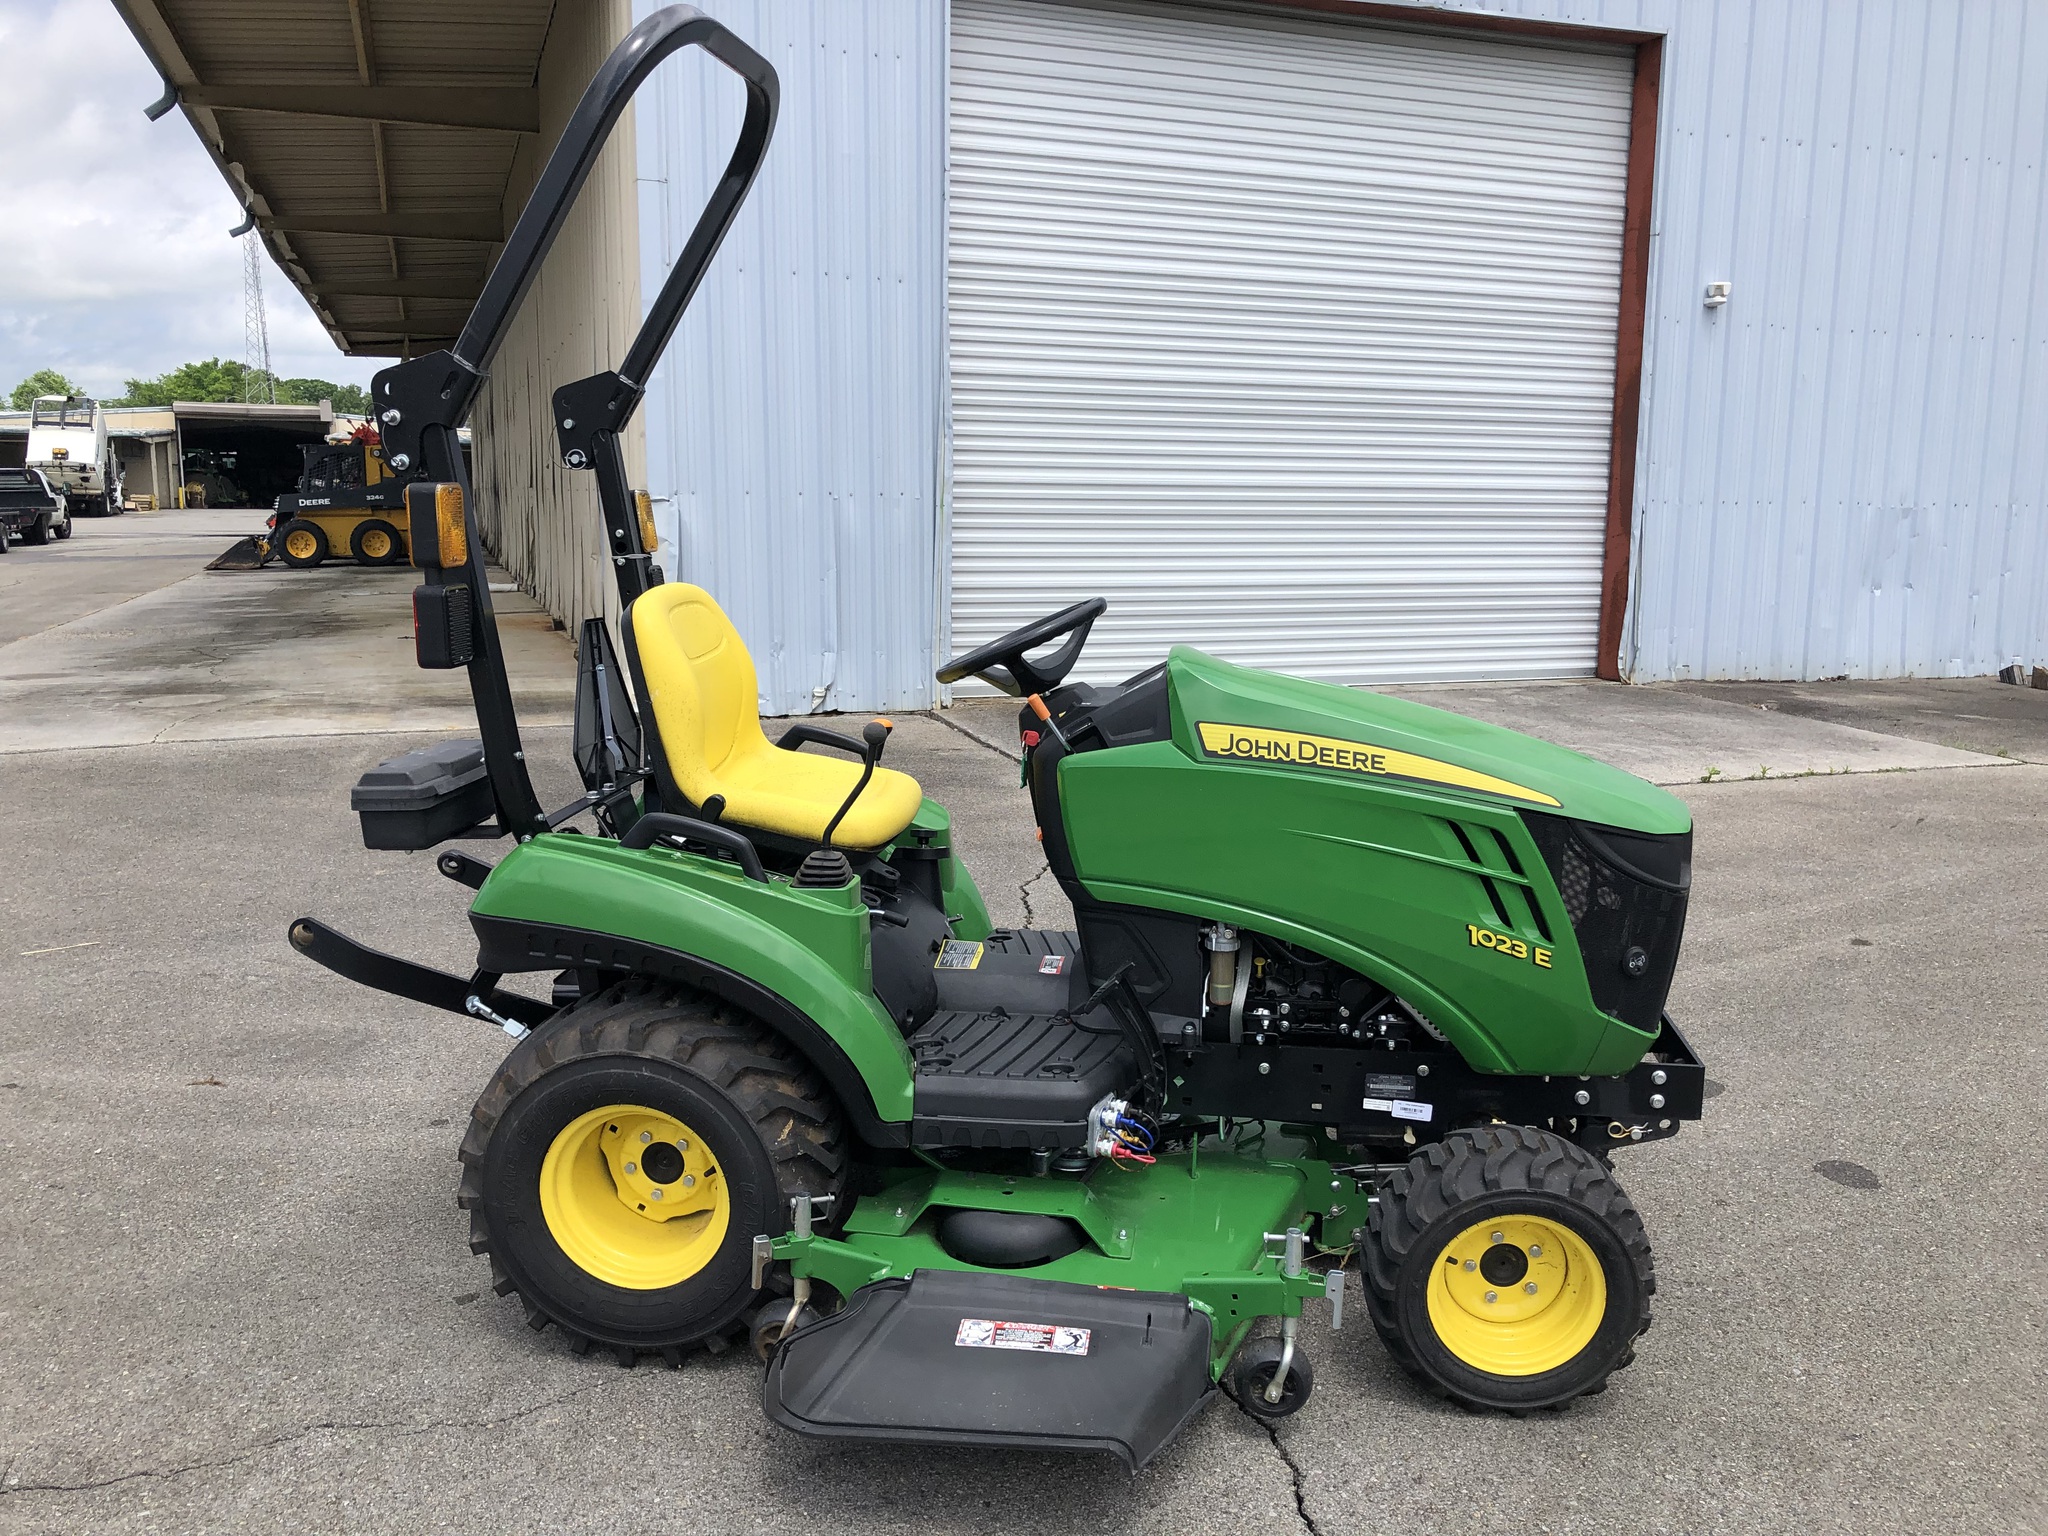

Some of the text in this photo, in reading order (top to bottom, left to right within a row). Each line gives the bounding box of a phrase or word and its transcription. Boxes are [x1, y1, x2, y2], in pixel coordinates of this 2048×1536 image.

[298, 498, 331, 507] DEERE
[1220, 733, 1386, 772] JOHN DEERE
[1467, 924, 1552, 969] 1023 E
